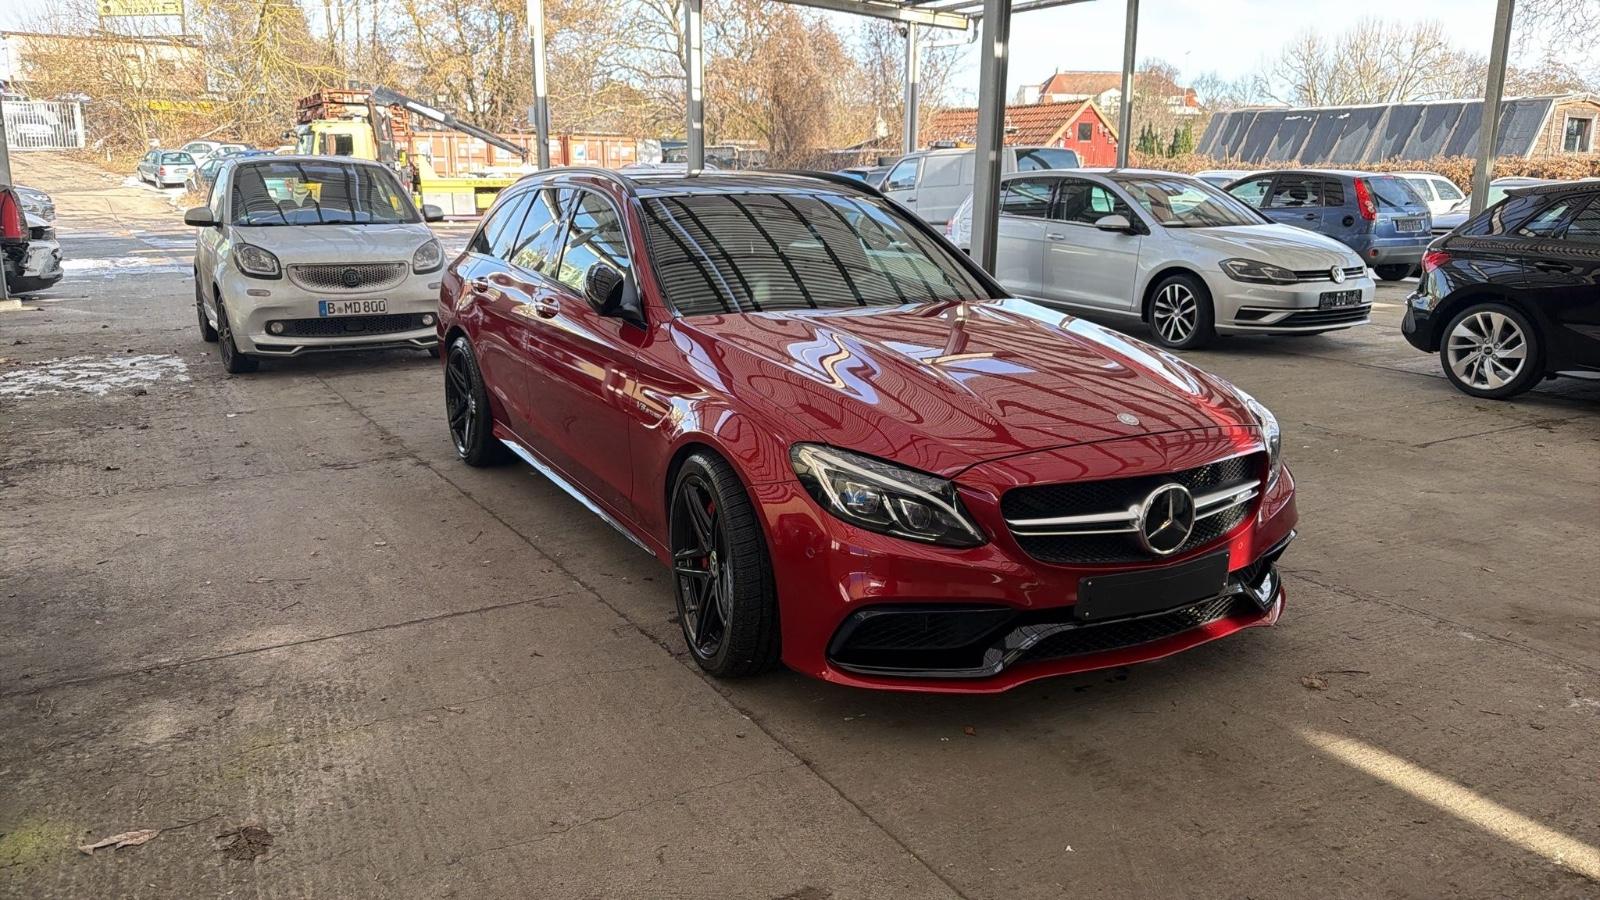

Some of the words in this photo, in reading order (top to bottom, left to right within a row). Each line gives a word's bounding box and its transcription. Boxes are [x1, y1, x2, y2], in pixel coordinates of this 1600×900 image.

[328, 303, 335, 314] B
[344, 302, 361, 313] MD
[363, 301, 386, 312] 800
